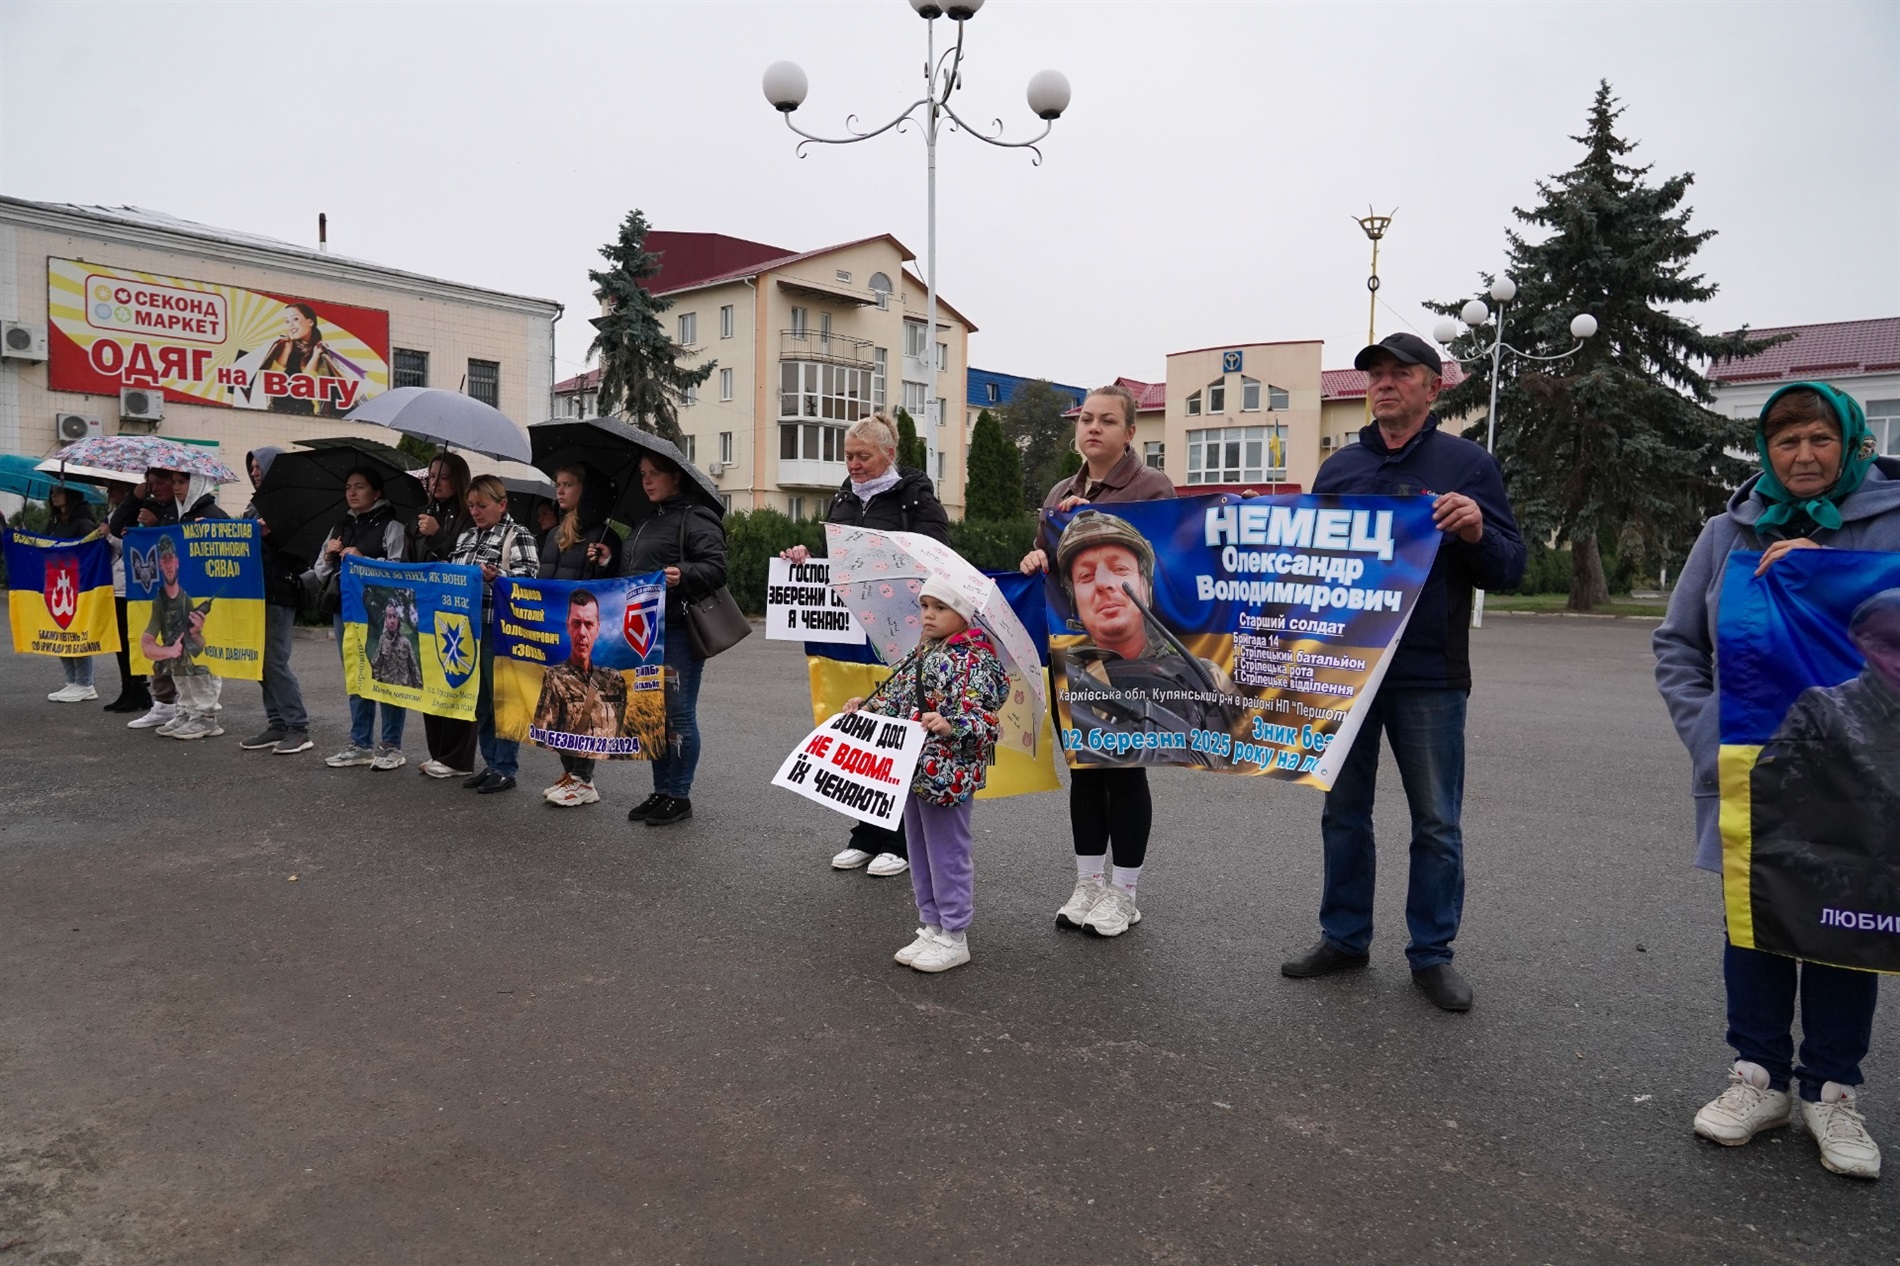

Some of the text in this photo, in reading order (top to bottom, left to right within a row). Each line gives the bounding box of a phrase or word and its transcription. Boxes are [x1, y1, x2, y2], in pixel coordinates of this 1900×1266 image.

[135, 290, 219, 319] СЕКОНД
[135, 310, 219, 335] МАРКЕТ
[90, 338, 360, 408] ОДЯГ на вагу
[182, 523, 210, 539] МАЗУР
[1205, 504, 1394, 560] НЕМЕЦ
[189, 542, 250, 557] ВАЛЕНТИНОВИЧ
[1222, 545, 1364, 586] Олександр
[428, 571, 441, 583] як
[441, 573, 467, 586] вони
[441, 594, 452, 606] за
[768, 585, 826, 606] ЗБЕРЕЖИ
[1196, 574, 1402, 613] Володимирович
[788, 609, 849, 631] Я ЧЕКАЮ!
[1239, 611, 1346, 635] Старший солдат
[1233, 632, 1279, 647] Бригада 14
[1240, 645, 1293, 662] Стрілецький
[1296, 651, 1366, 669] батальйон
[1240, 659, 1287, 676] Стрілецька
[1289, 665, 1314, 678] рота
[1240, 671, 1288, 687] Стрілецьке
[1290, 677, 1354, 695] відділення
[1059, 687, 1122, 704] Харківська
[1152, 688, 1217, 704] Купянський
[1219, 694, 1233, 706] р-н
[1242, 694, 1274, 712] районі
[1275, 699, 1290, 714] НП
[548, 731, 595, 752] БЕЗВІСТИ
[830, 712, 907, 750] ВОНИ ДОСІ
[1252, 715, 1298, 747] Зник
[804, 734, 900, 786] НЕ ВДОМА...
[1062, 728, 1083, 751] 02
[1088, 727, 1187, 755] березня
[1190, 728, 1231, 757] 2025
[1232, 741, 1276, 770] року
[1276, 751, 1301, 771] на
[787, 753, 896, 820] ЇХ ЧЕКАЮТЬ!
